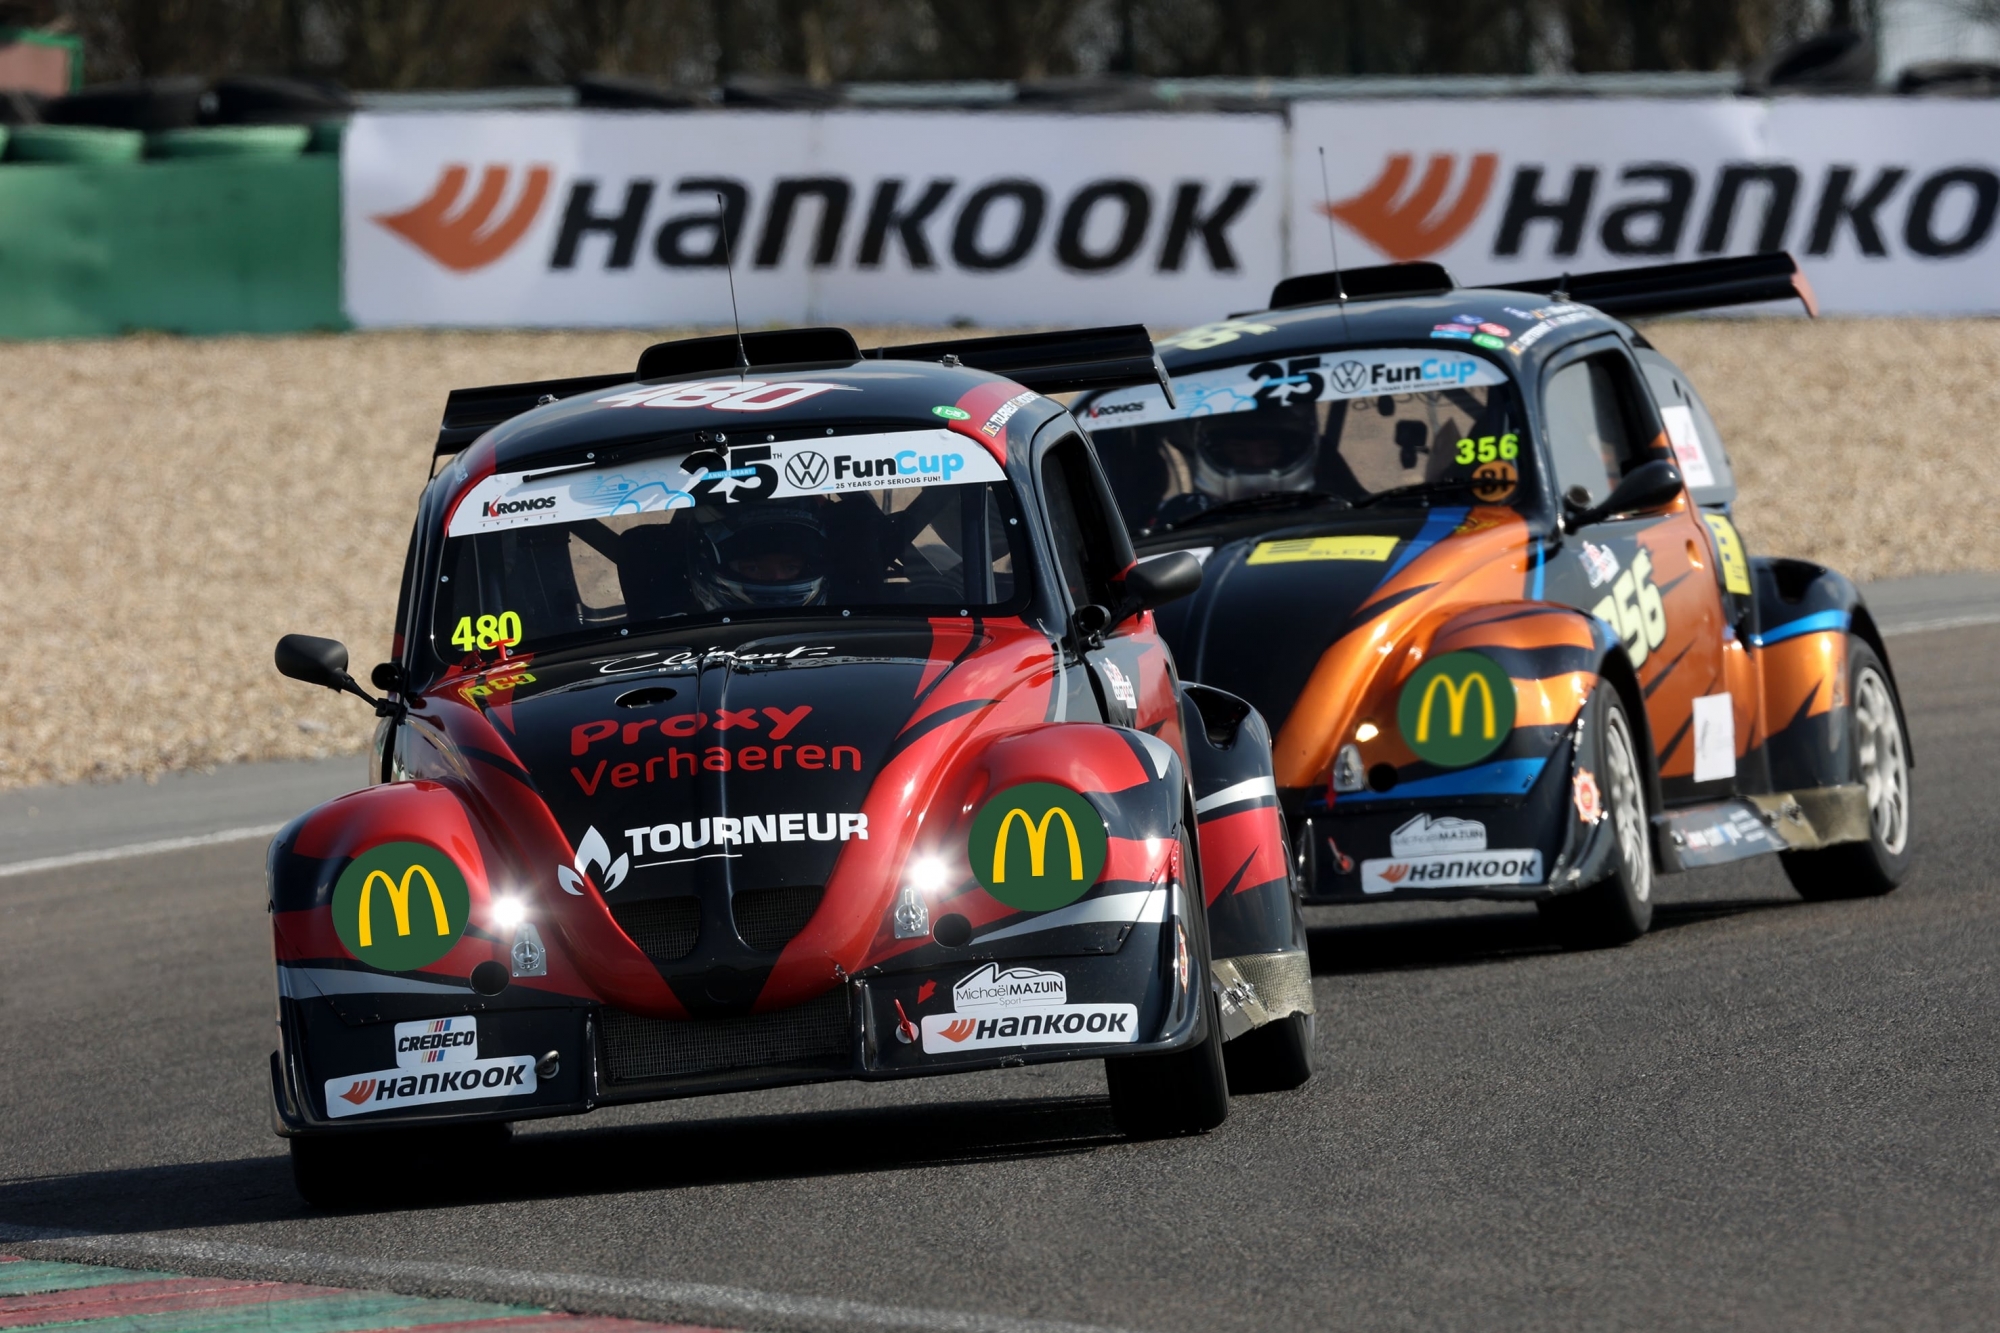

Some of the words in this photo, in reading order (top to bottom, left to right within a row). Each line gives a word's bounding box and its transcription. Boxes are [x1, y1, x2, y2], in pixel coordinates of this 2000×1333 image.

[1371, 358, 1477, 385] FunCup
[1455, 433, 1518, 465] 356
[834, 450, 964, 481] FunCup
[887, 477, 921, 485] SERIOUS
[482, 495, 556, 517] KRONOS
[451, 611, 522, 652] 480
[571, 705, 813, 756] Proxy
[571, 744, 862, 796] Verhaeren
[624, 812, 869, 857] TOURNEUR
[999, 996, 1022, 1007] Sport
[398, 1030, 475, 1053] CREDECO
